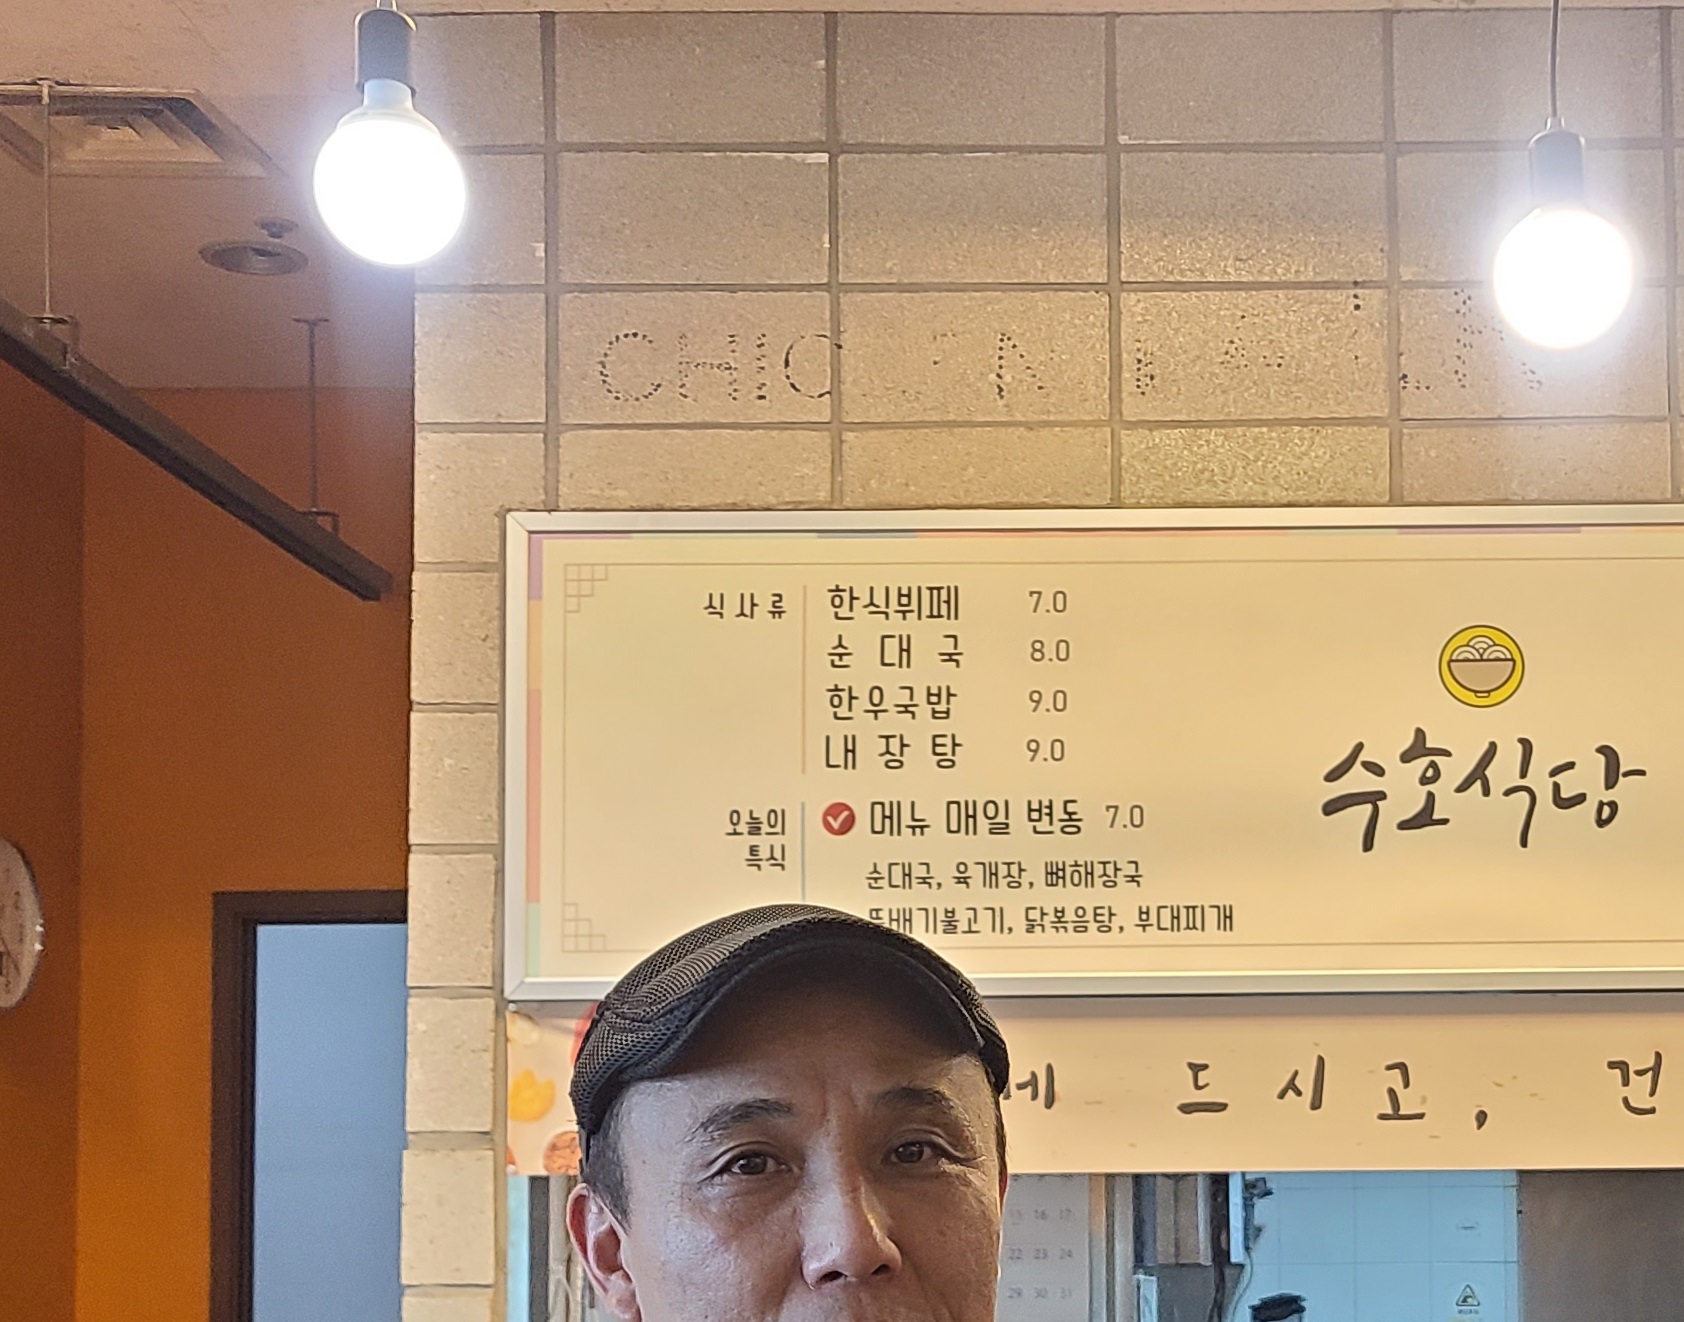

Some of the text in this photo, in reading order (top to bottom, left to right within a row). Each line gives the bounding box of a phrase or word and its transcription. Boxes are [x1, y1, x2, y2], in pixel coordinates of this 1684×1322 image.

[826, 583, 1068, 622] 한식뷔페 7.0
[1029, 638, 1071, 664] 8.0
[825, 682, 1069, 722] 한우국밥 9.0
[1025, 737, 1066, 763] 9.0
[1320, 725, 1648, 854] 수호식당
[724, 807, 787, 837] 오늘의
[869, 797, 1145, 838] 메뉴 매일 변동 7.0
[743, 842, 787, 873] 특식
[864, 858, 1144, 891] 순대국, 육개장, 뼈해장국
[1023, 904, 1125, 935] 닭볶음탕,
[1133, 903, 1234, 934] 부대찌개
